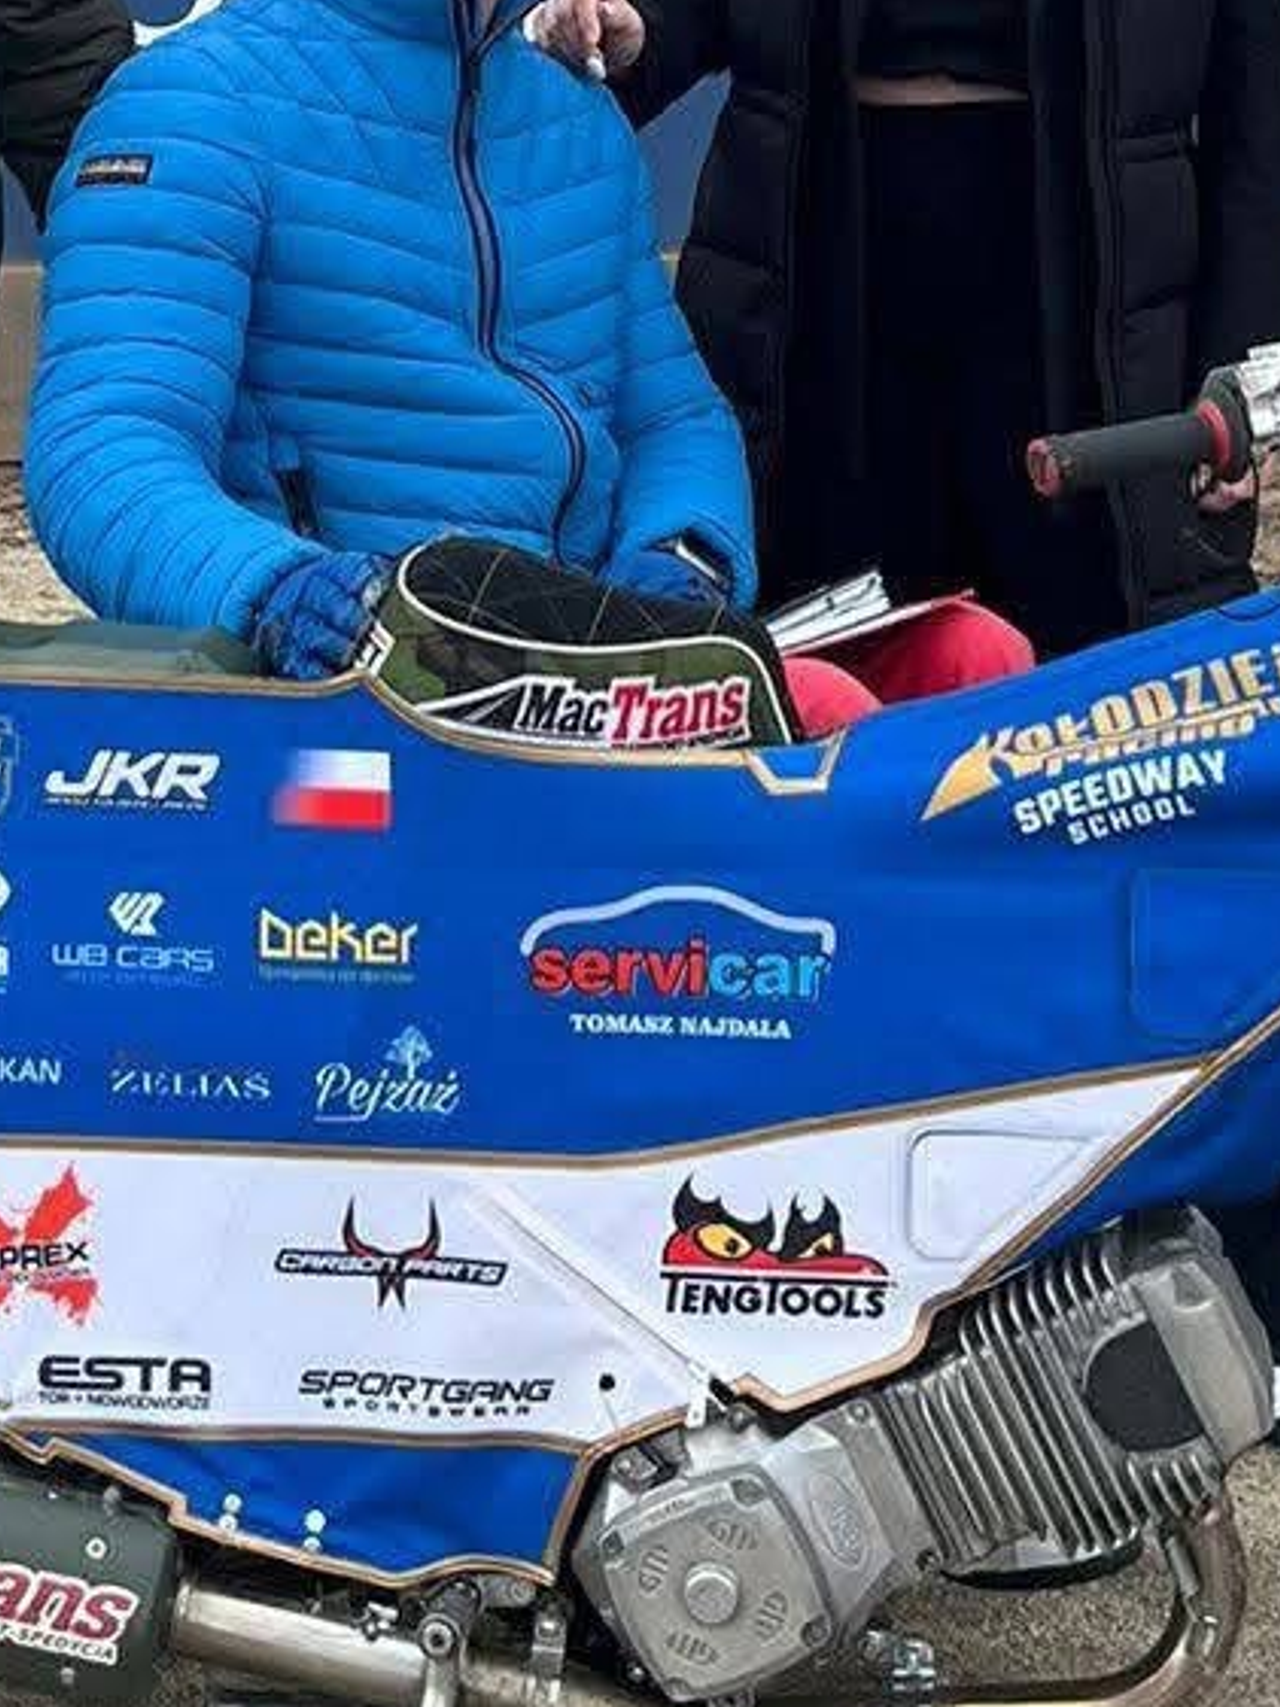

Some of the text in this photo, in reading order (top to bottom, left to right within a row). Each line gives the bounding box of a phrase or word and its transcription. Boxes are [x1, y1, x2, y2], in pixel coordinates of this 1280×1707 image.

[519, 677, 748, 742] MacTrans
[45, 749, 220, 801] JKR
[1014, 749, 1227, 834] SPEEDWAY
[1067, 793, 1196, 846] SCHOOL
[529, 939, 830, 996] servicar
[570, 1014, 674, 1034] TOMASZ
[37, 1355, 213, 1392] ESTA
[298, 1370, 555, 1404] SPORTGANG
